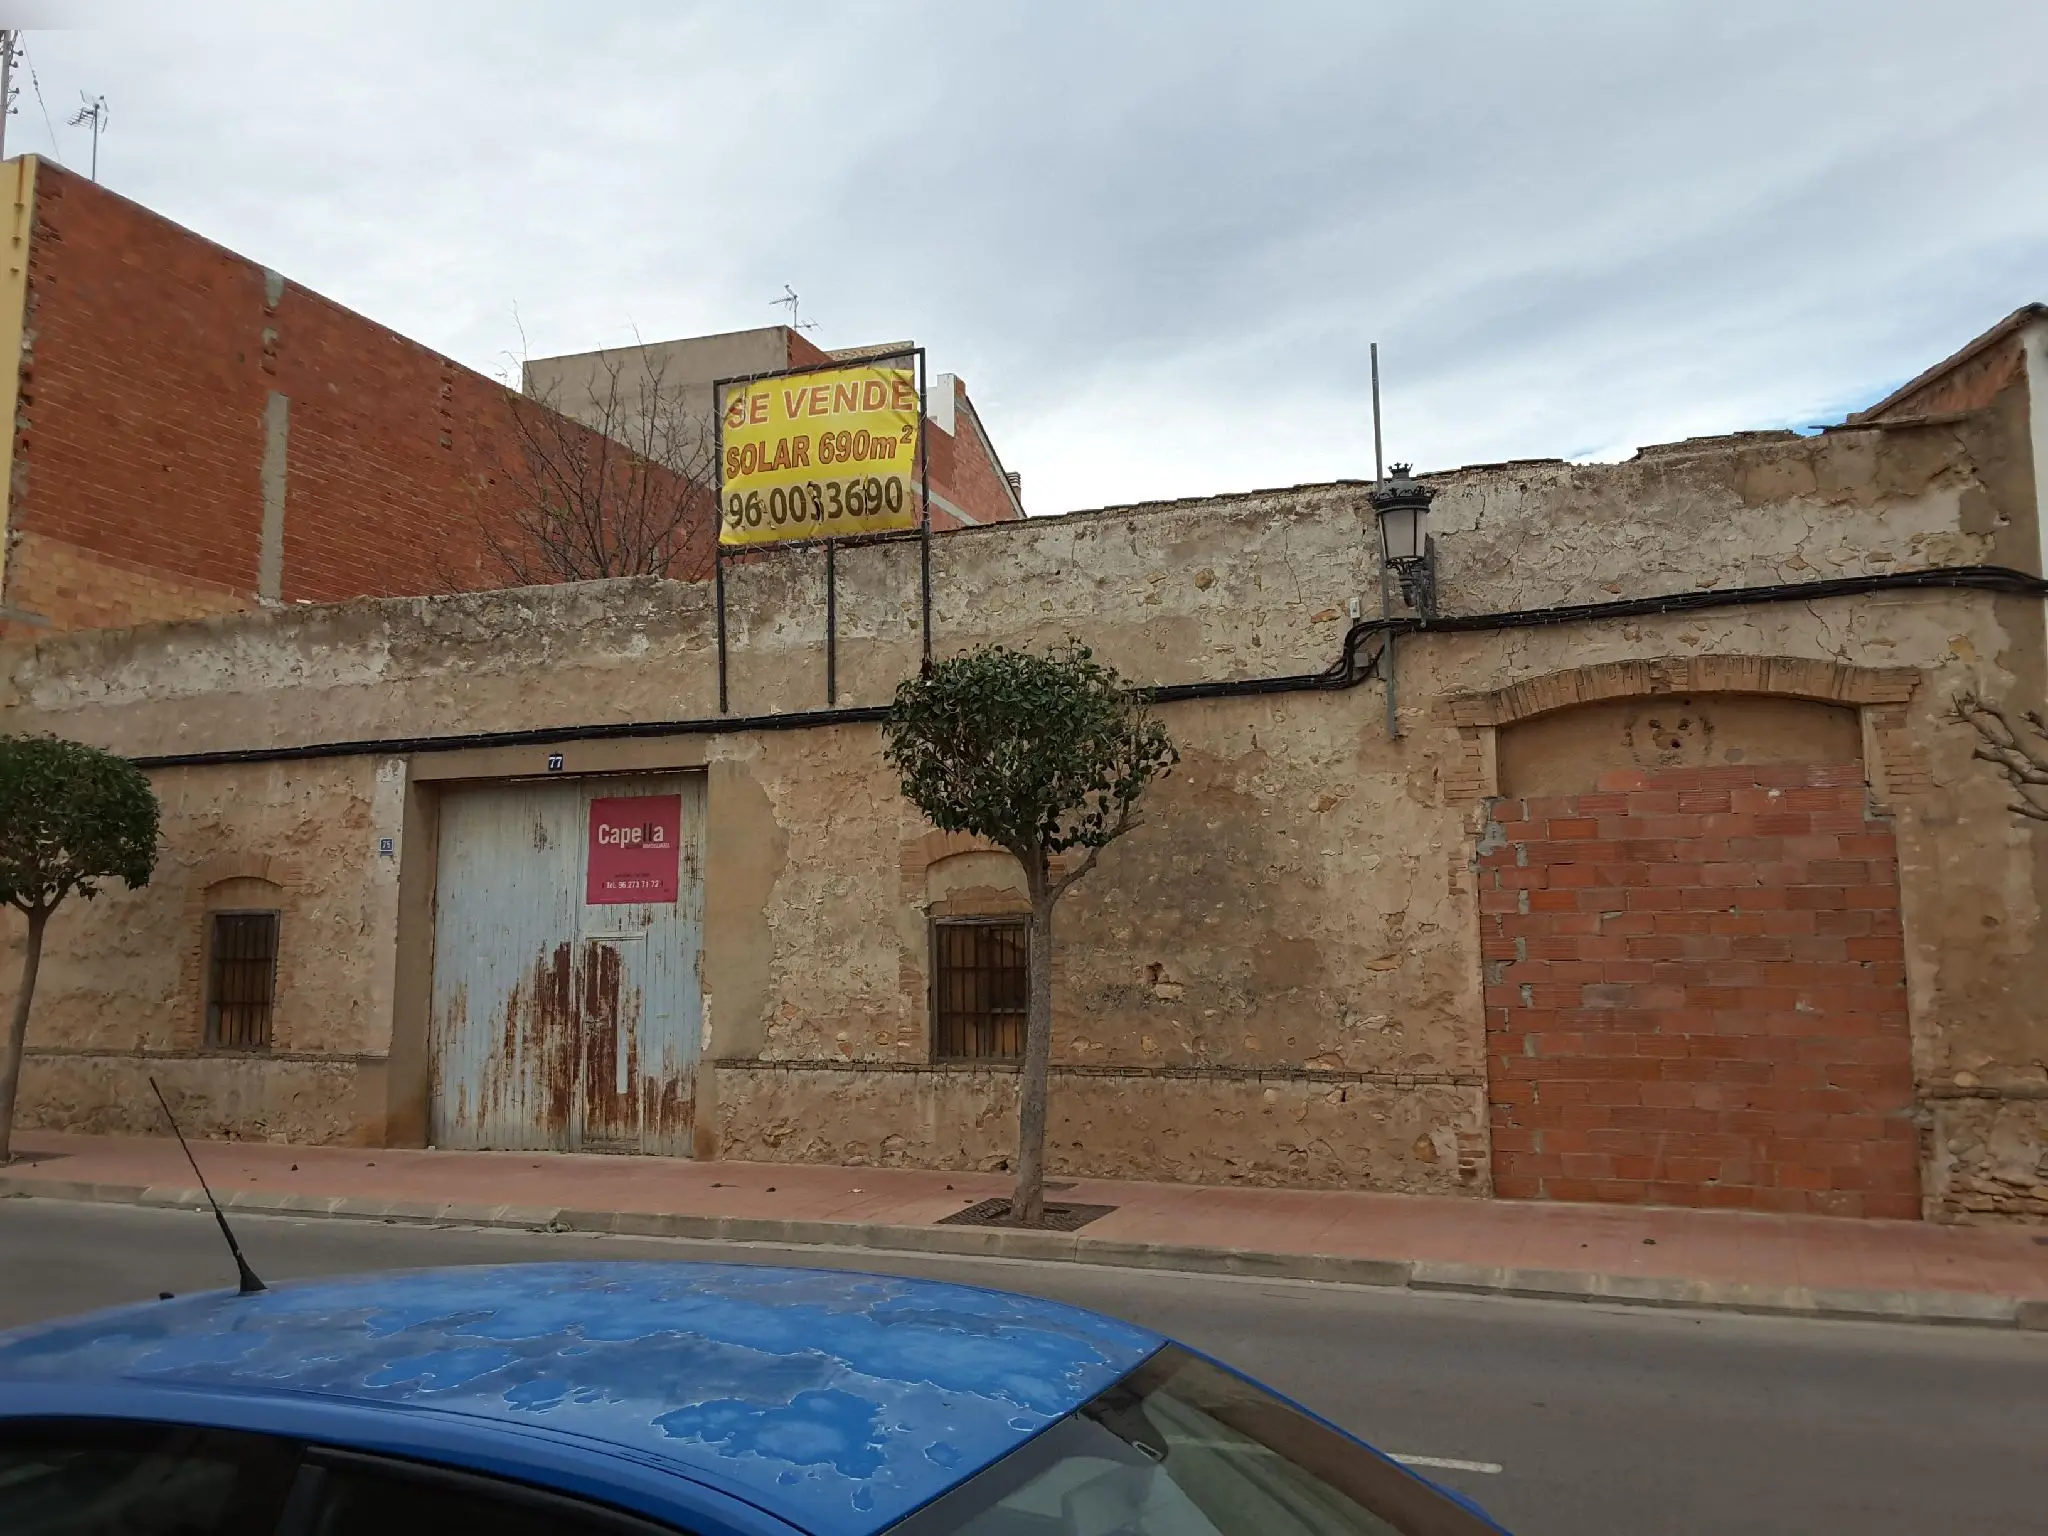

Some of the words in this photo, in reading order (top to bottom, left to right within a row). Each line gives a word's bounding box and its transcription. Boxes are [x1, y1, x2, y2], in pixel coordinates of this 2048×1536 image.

[727, 392, 770, 429] SE
[784, 380, 913, 419] VENDE
[726, 434, 810, 479] SOLAR
[549, 756, 563, 769] 77
[598, 823, 664, 849] Capella
